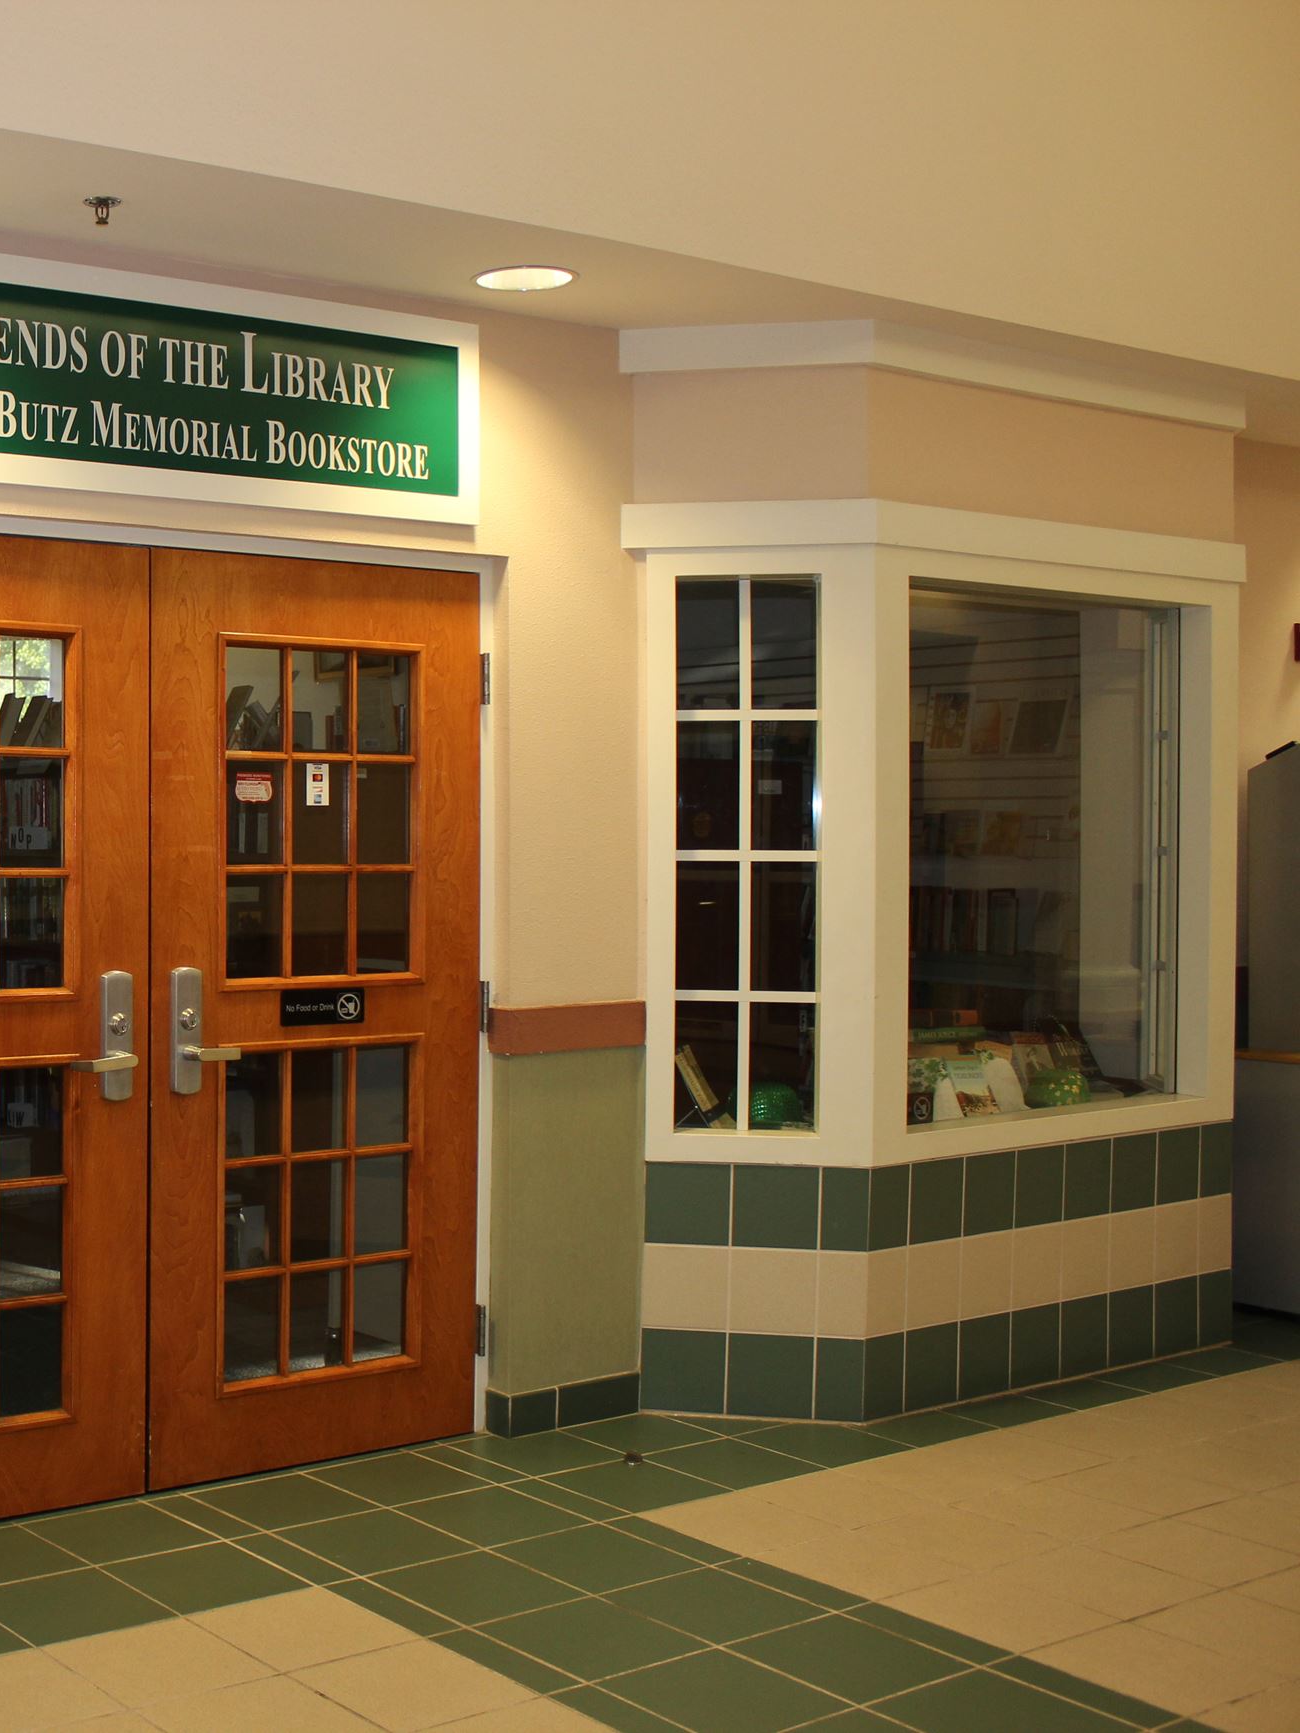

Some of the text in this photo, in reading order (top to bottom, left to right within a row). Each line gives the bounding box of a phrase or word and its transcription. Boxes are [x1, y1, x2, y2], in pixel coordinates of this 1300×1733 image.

[100, 329, 149, 380] OF
[158, 337, 229, 389] THE
[240, 331, 395, 410] LIBRARY
[90, 400, 258, 461] MEMORIAL
[266, 420, 429, 481] BOOKSTORE
[285, 1004, 296, 1013] No
[296, 1003, 311, 1012] Food
[319, 1002, 335, 1011] Drink
